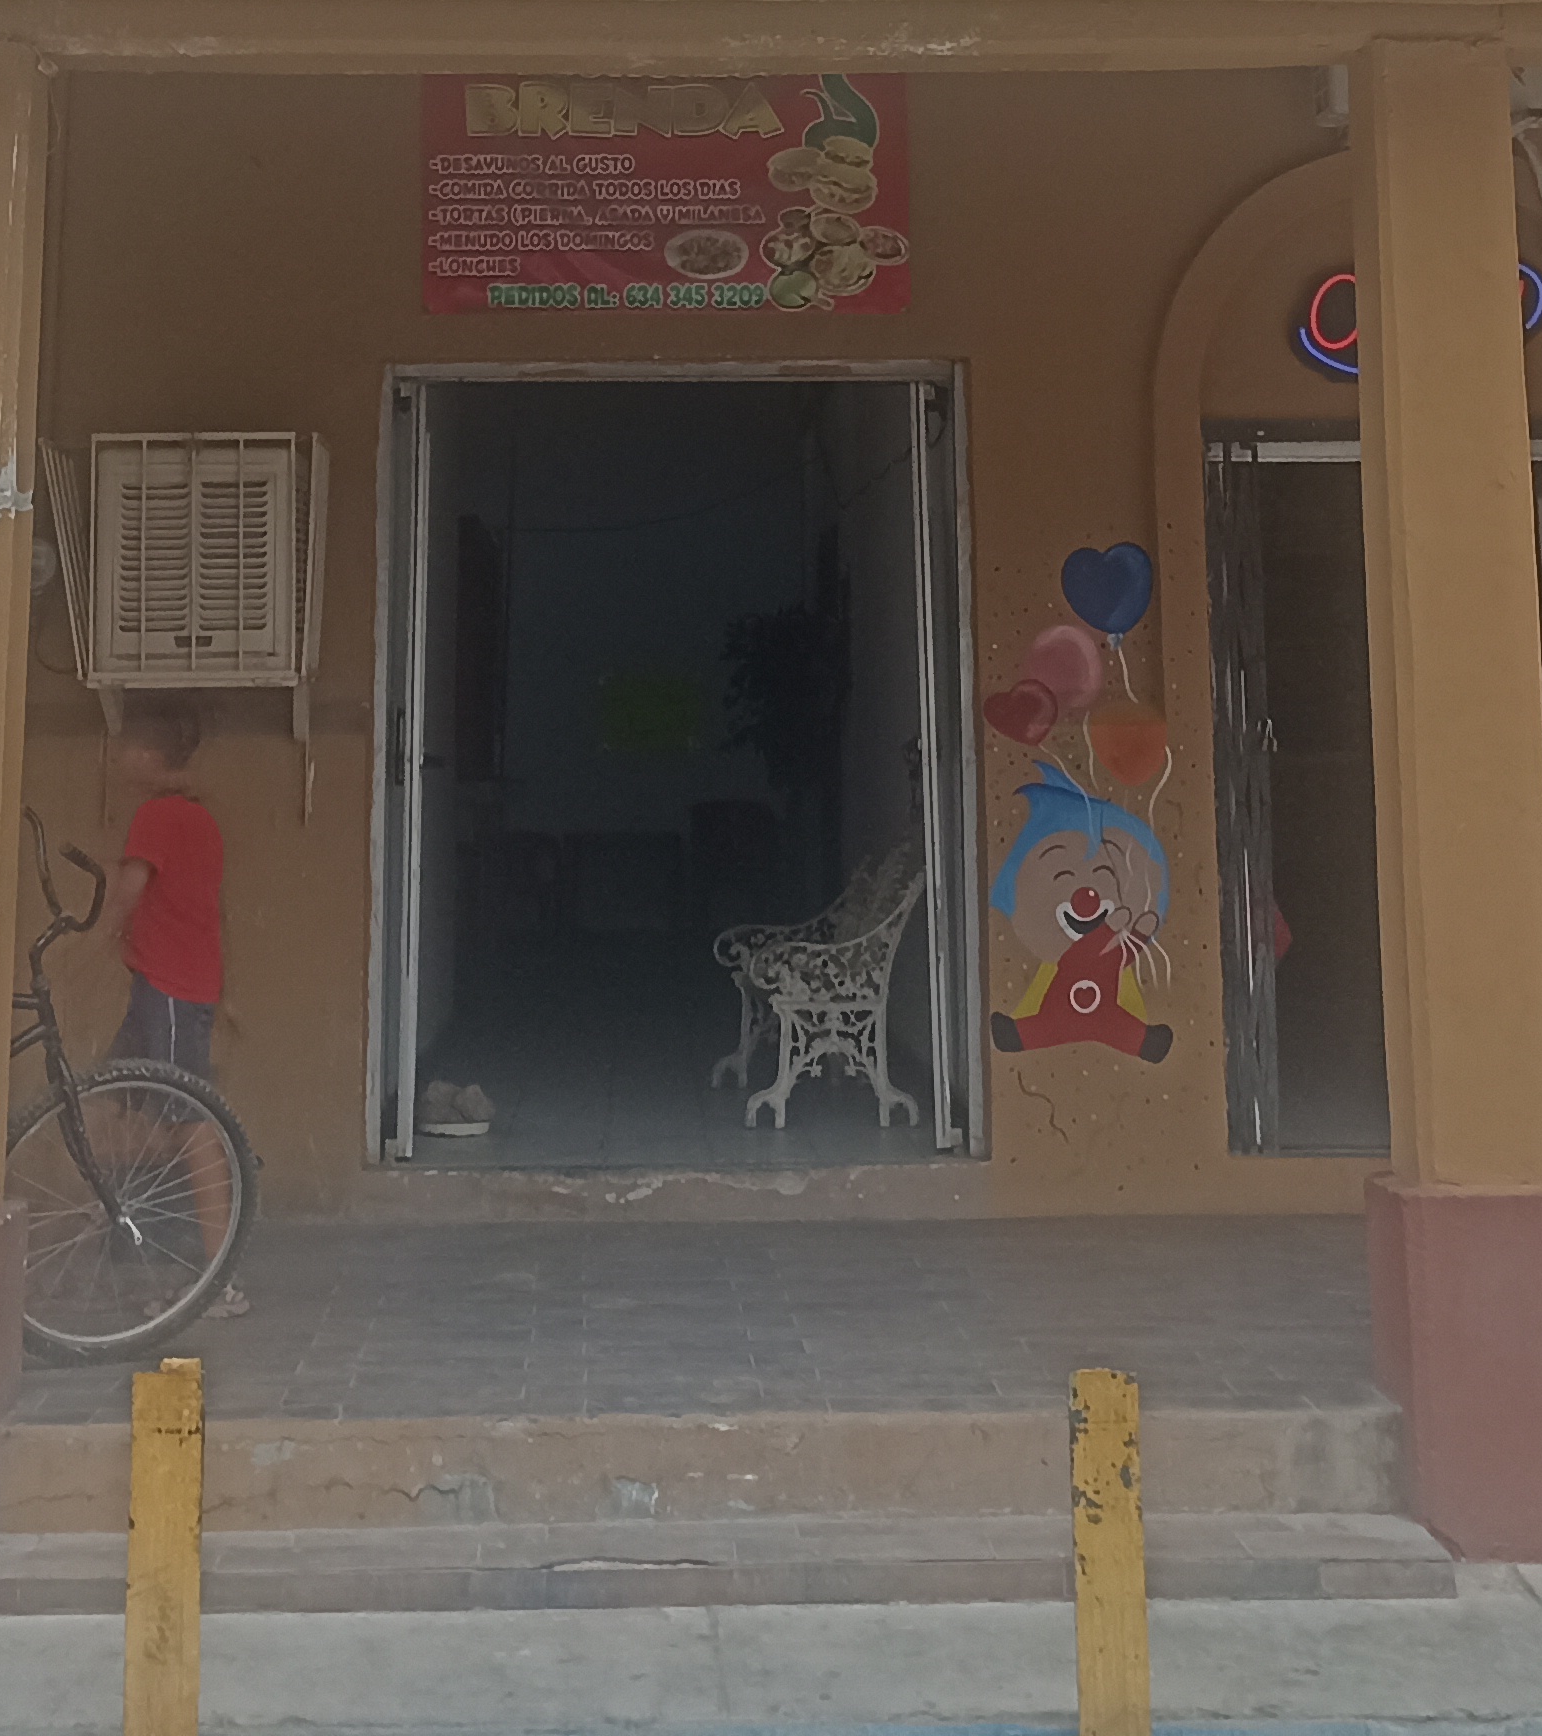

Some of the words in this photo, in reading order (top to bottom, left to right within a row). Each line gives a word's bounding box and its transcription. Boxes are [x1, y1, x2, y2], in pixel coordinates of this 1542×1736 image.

[464, 81, 785, 140] BRENDA
[545, 155, 571, 174] AL
[573, 154, 635, 174] GUSTO
[509, 179, 591, 200] CORRIDA
[593, 179, 656, 200] TODOS
[657, 179, 695, 200] LOS
[696, 179, 741, 200] DIAS
[594, 205, 656, 225] ASADA
[517, 230, 555, 250] LOS
[556, 230, 655, 251] DOMINGOS
[487, 283, 581, 309] PEDIDOS
[623, 282, 664, 309] 634
[666, 282, 709, 309] 345
[711, 282, 767, 309] 3209
